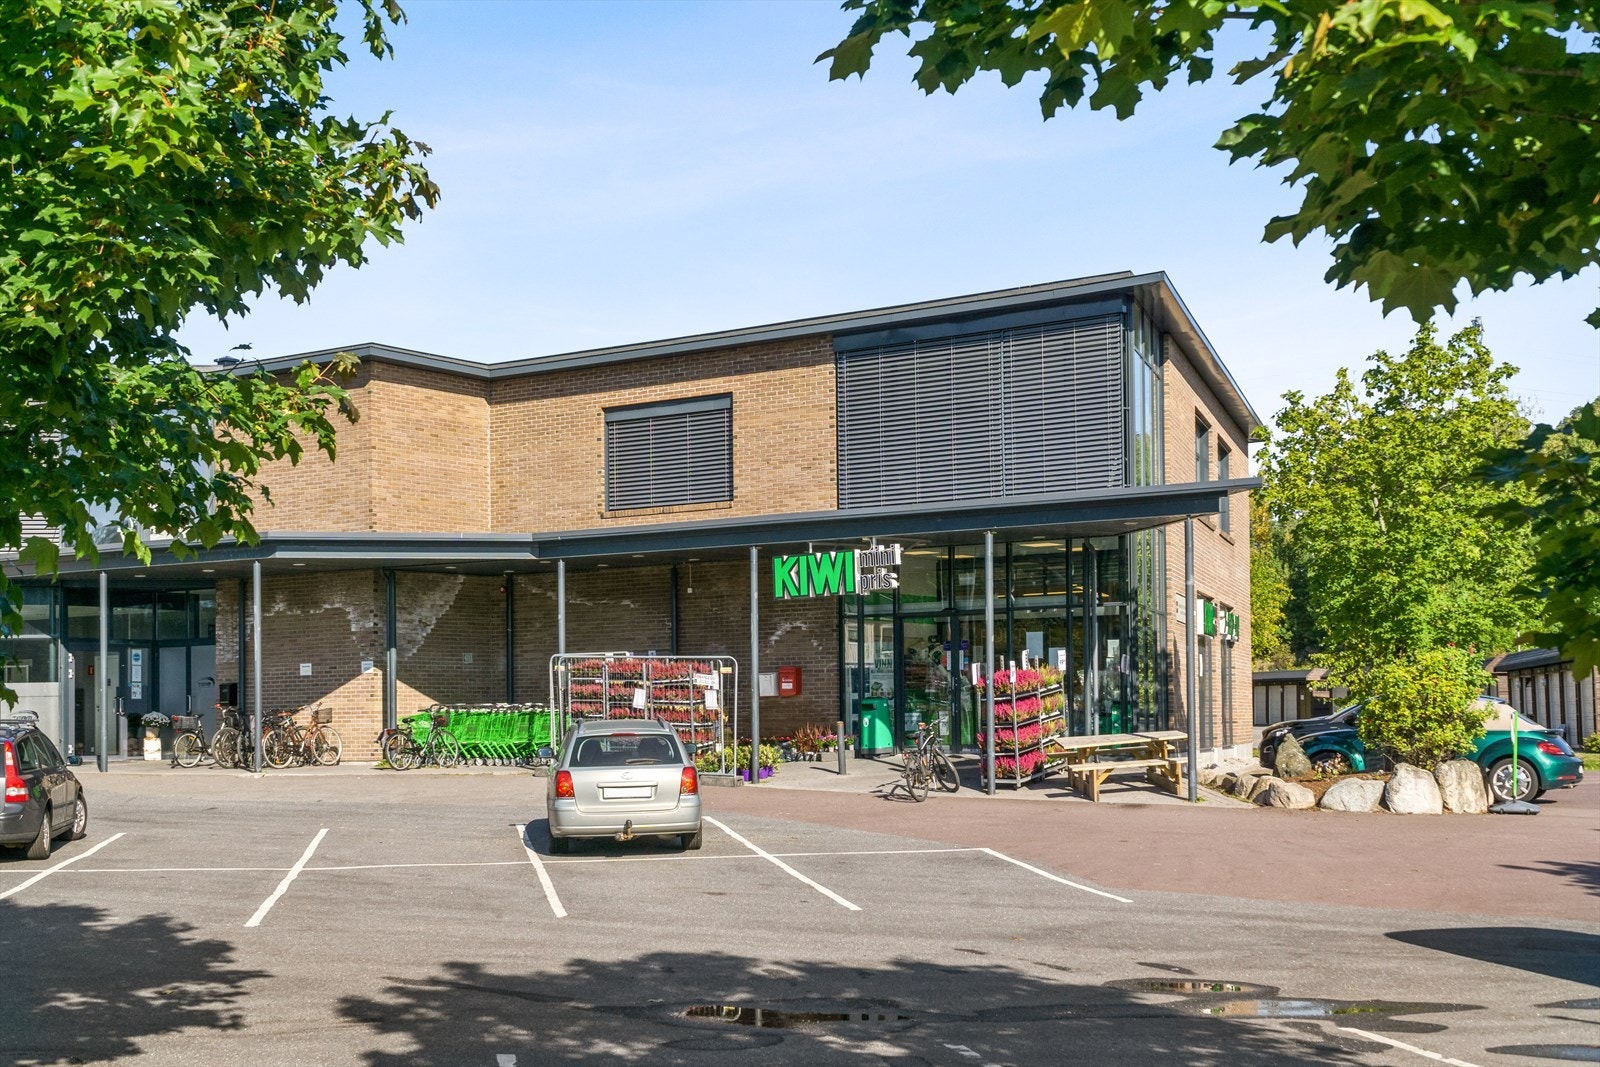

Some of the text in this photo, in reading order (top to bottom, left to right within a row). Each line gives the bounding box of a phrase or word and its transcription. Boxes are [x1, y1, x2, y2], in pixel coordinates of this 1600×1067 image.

[859, 544, 896, 567] mini
[773, 550, 855, 599] KIWI
[860, 567, 893, 595] pris
